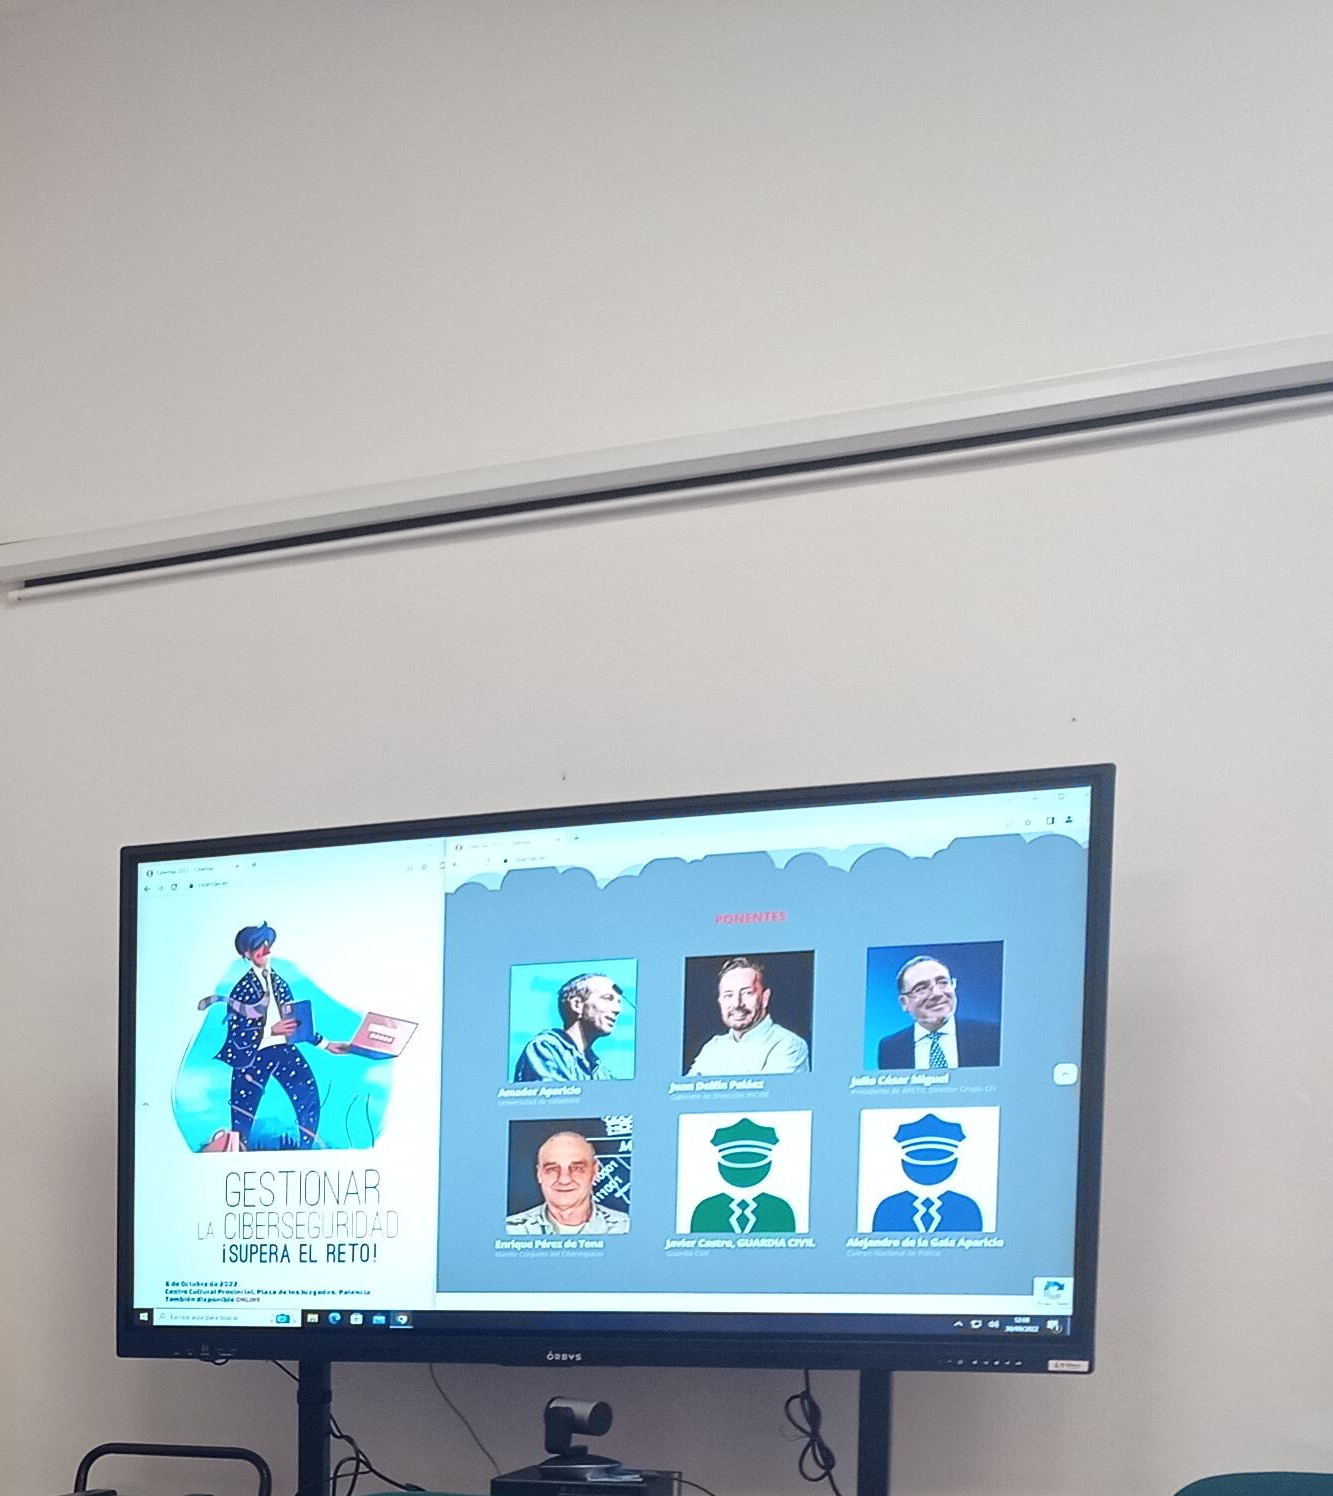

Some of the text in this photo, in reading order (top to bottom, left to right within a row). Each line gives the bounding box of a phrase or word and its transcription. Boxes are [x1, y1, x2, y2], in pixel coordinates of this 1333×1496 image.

[716, 911, 787, 924] PONENTES
[225, 1168, 381, 1208] GESTIONAR
[197, 1210, 399, 1240] LA CIBERSEGURIDAD
[222, 1243, 377, 1264] ¡SUPERA EL RETO!
